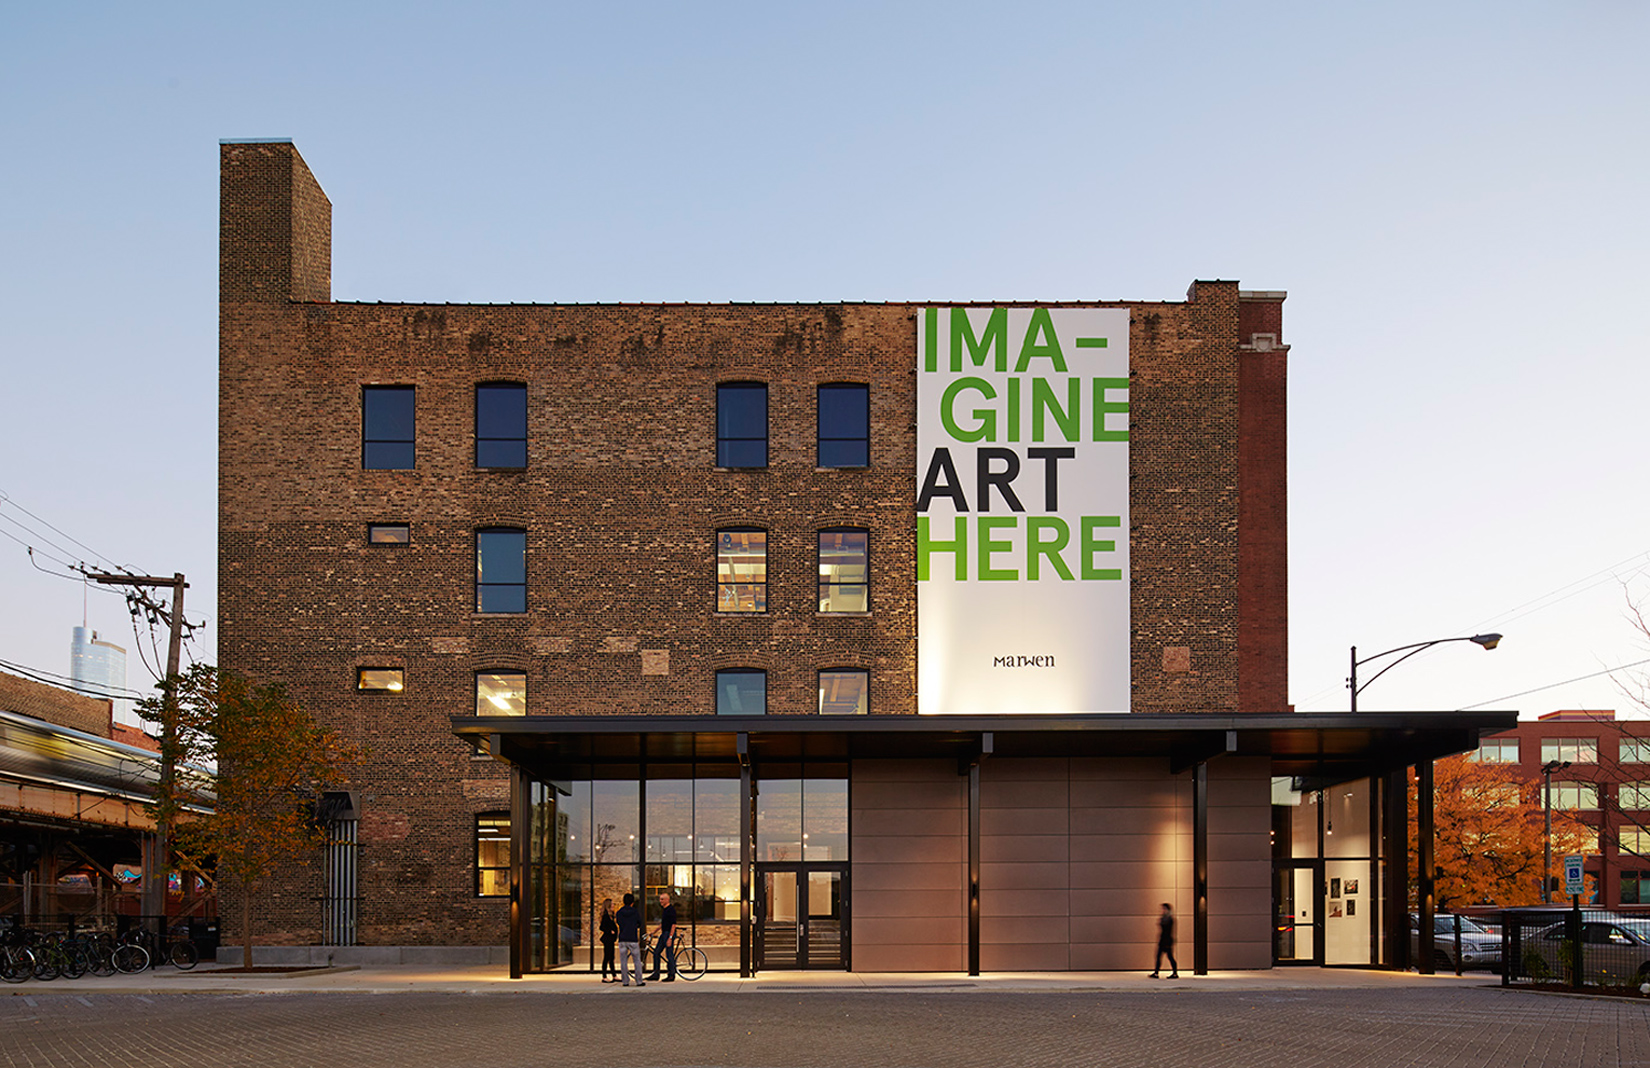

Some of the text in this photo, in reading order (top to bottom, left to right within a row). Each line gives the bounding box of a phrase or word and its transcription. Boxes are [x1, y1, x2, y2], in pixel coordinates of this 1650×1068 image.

[925, 307, 1107, 372] IMA-
[940, 377, 1129, 442] GINE
[917, 447, 1075, 512] ART
[917, 516, 1122, 581] HERE
